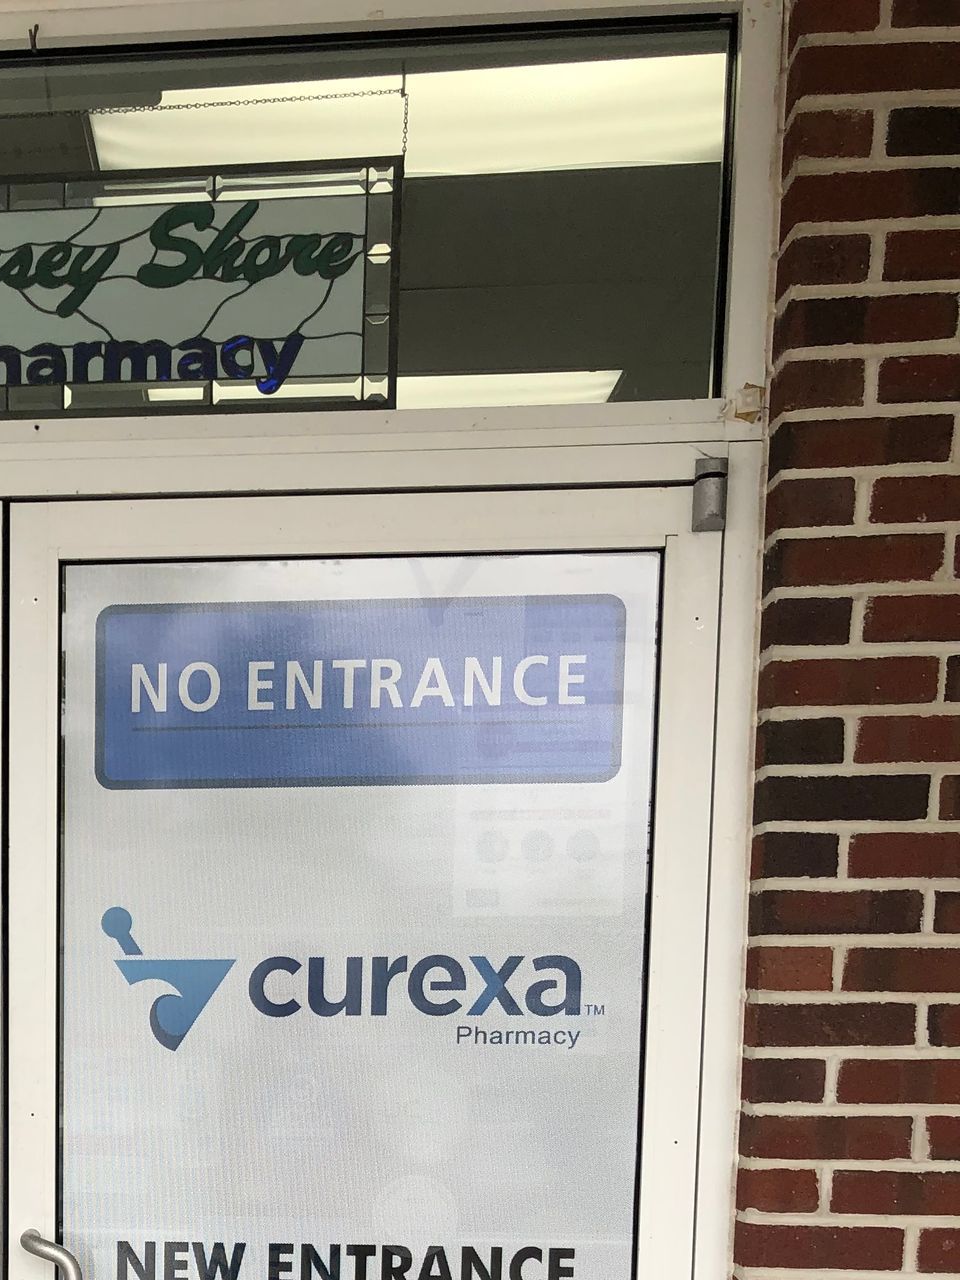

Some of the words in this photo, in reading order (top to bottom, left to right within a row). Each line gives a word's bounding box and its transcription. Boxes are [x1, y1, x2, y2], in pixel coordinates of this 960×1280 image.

[137, 200, 355, 288] Shore
[131, 661, 221, 714] NO
[248, 654, 588, 711] ENTRANCE
[249, 954, 581, 1019] curexa
[456, 1026, 580, 1050] Pharmacy
